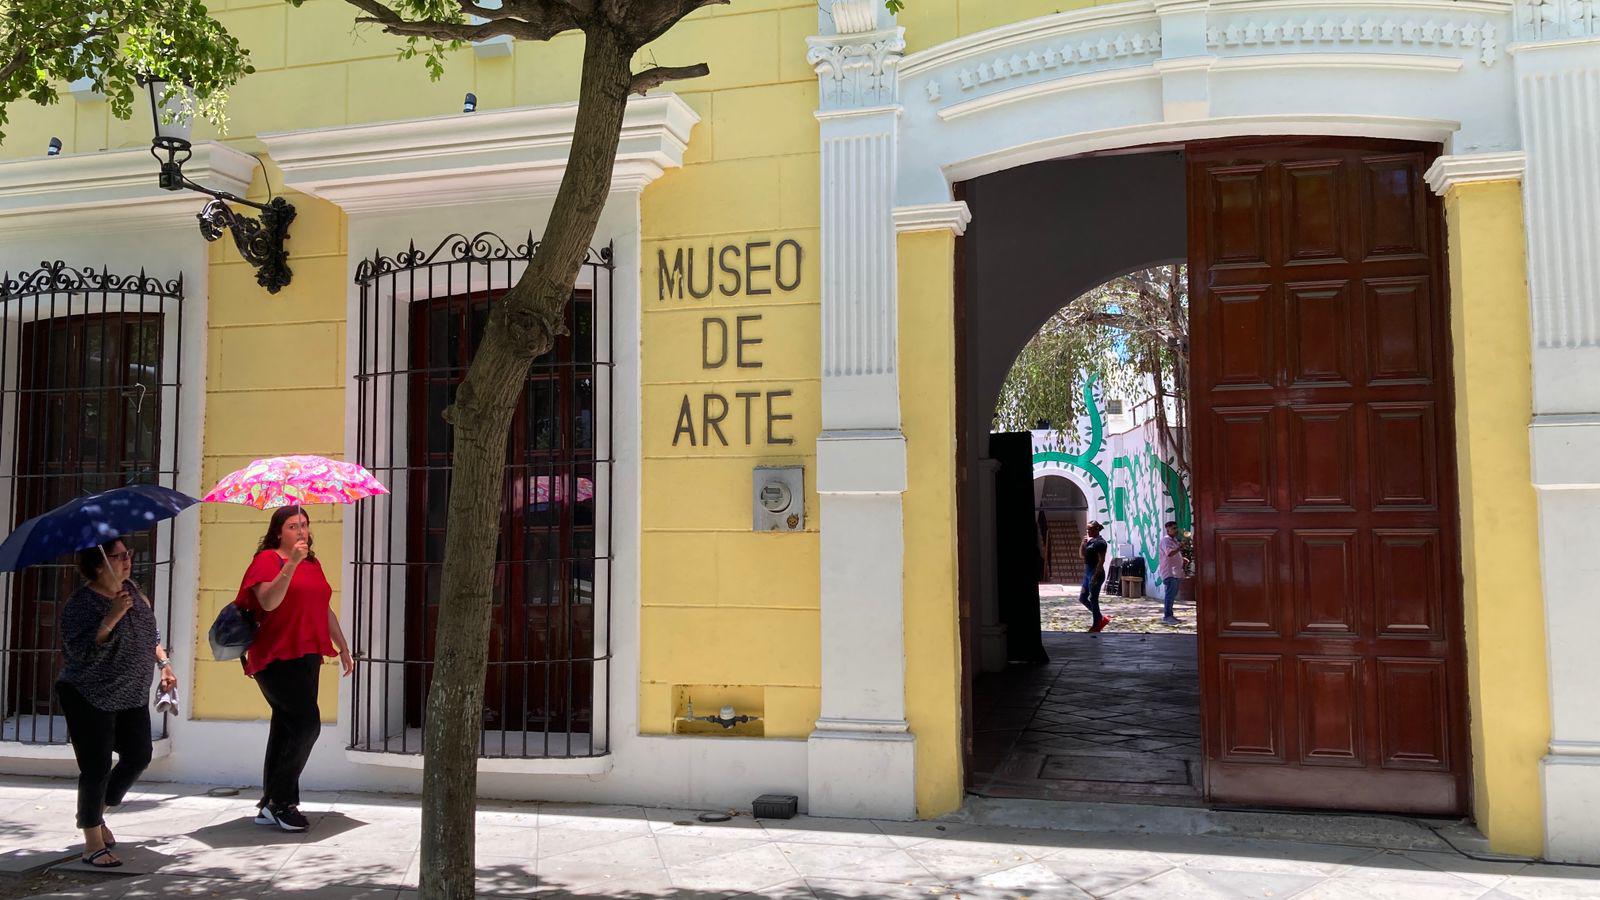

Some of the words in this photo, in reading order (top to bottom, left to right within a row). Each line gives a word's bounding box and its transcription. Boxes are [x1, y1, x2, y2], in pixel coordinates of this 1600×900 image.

[658, 239, 803, 301] MUSEO
[702, 315, 763, 370] DE
[673, 390, 795, 447] ARTE
